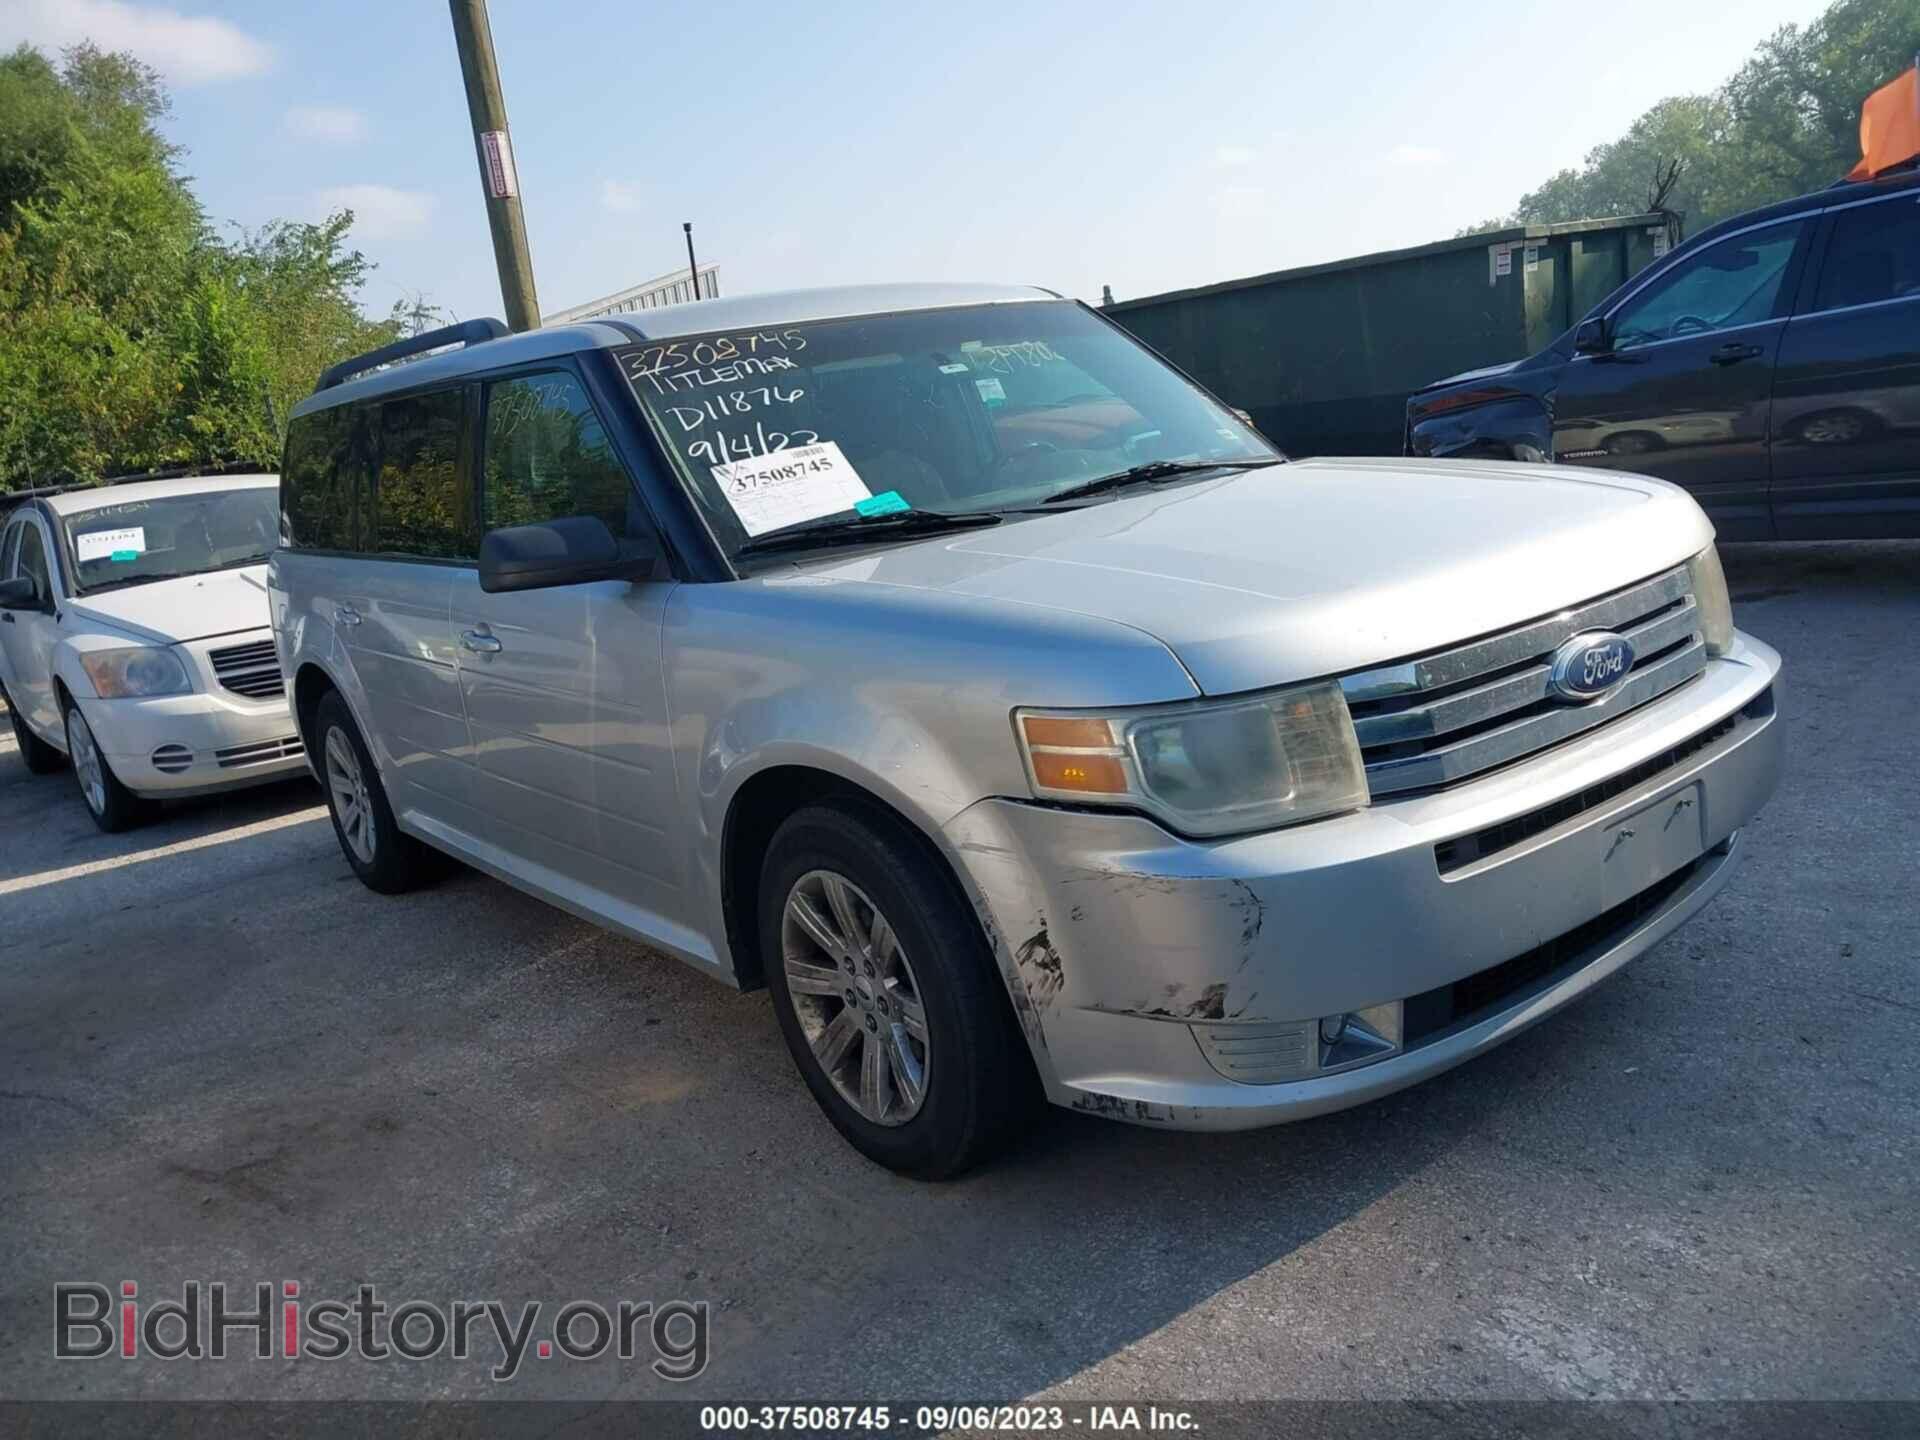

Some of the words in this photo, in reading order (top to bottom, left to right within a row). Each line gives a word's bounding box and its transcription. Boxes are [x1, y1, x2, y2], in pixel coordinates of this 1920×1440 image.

[642, 356, 799, 394] TITLEMAX
[665, 386, 804, 431] D11876
[736, 457, 833, 492] 37508745
[1583, 644, 1623, 685] Ford
